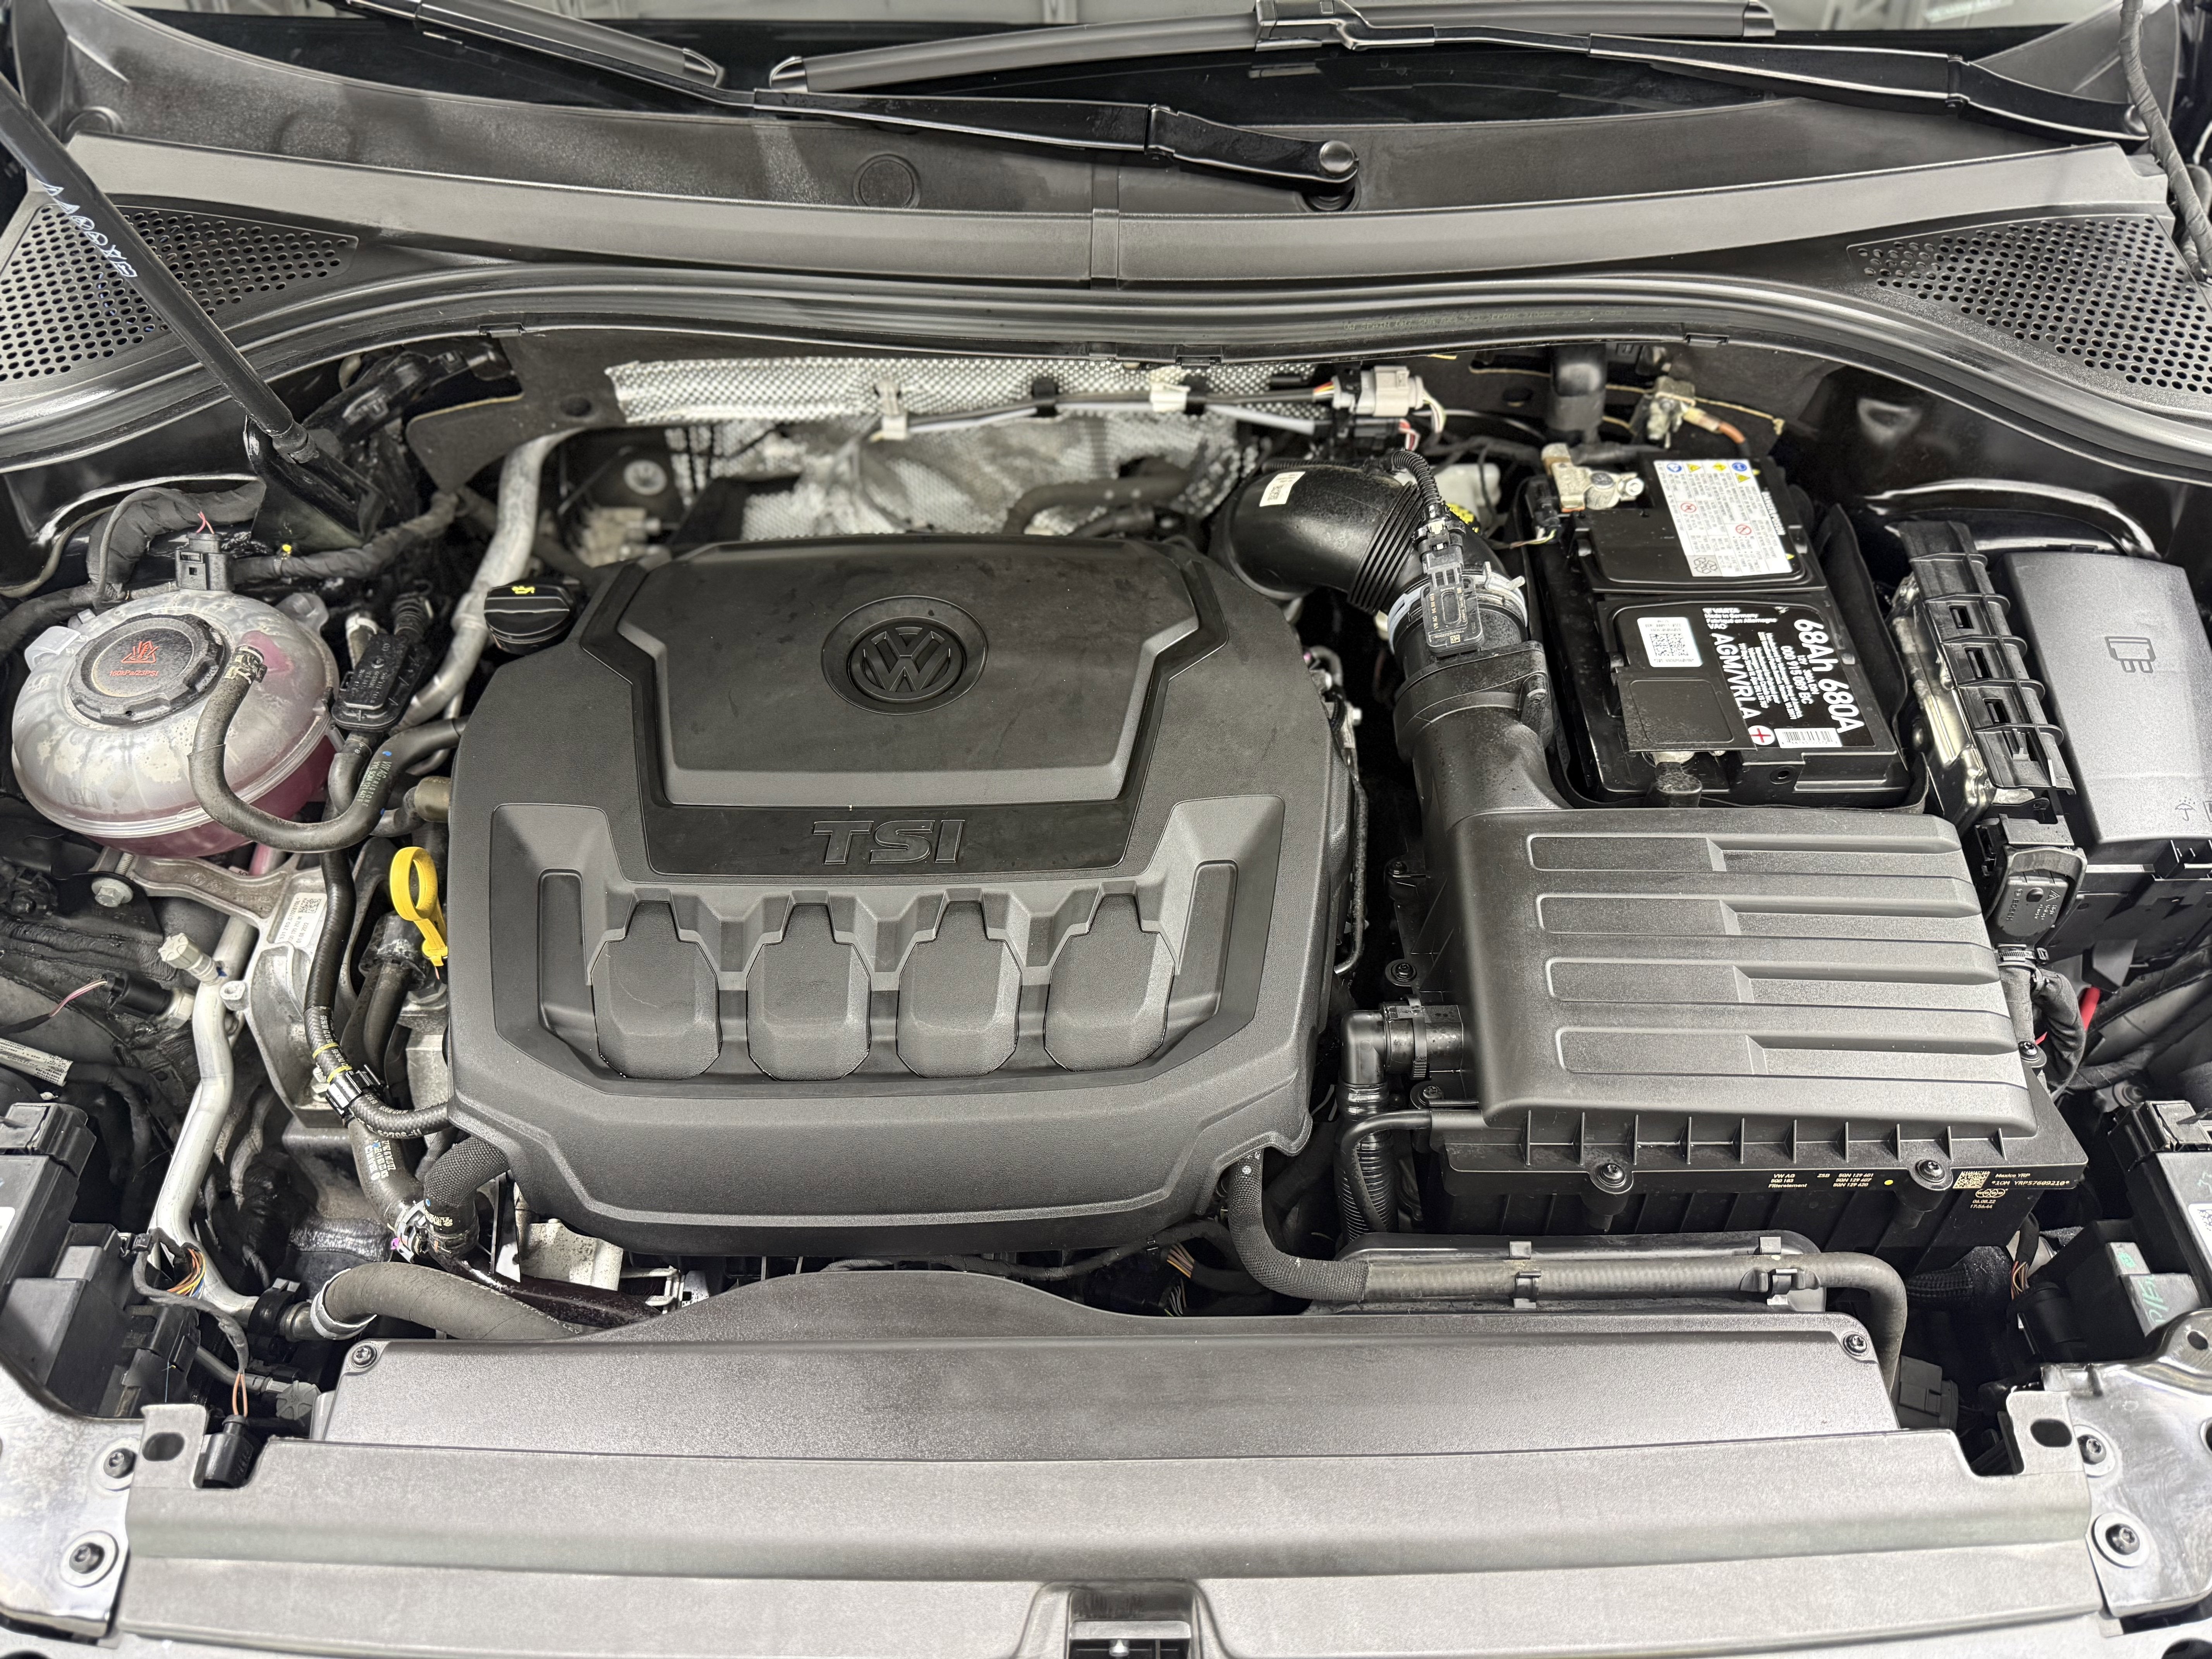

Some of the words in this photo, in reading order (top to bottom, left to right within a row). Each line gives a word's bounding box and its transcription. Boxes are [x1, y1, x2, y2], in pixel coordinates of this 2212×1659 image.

[1711, 633, 1762, 719] AGM/VRLA
[1786, 661, 1803, 675] 915
[1798, 692, 1814, 704] BC
[1794, 619, 1839, 672] 68Ah
[1818, 678, 1865, 733] 680A
[813, 819, 965, 865] TSI
[2006, 898, 2020, 921] BOSCH
[546, 1315, 560, 1324] NK
